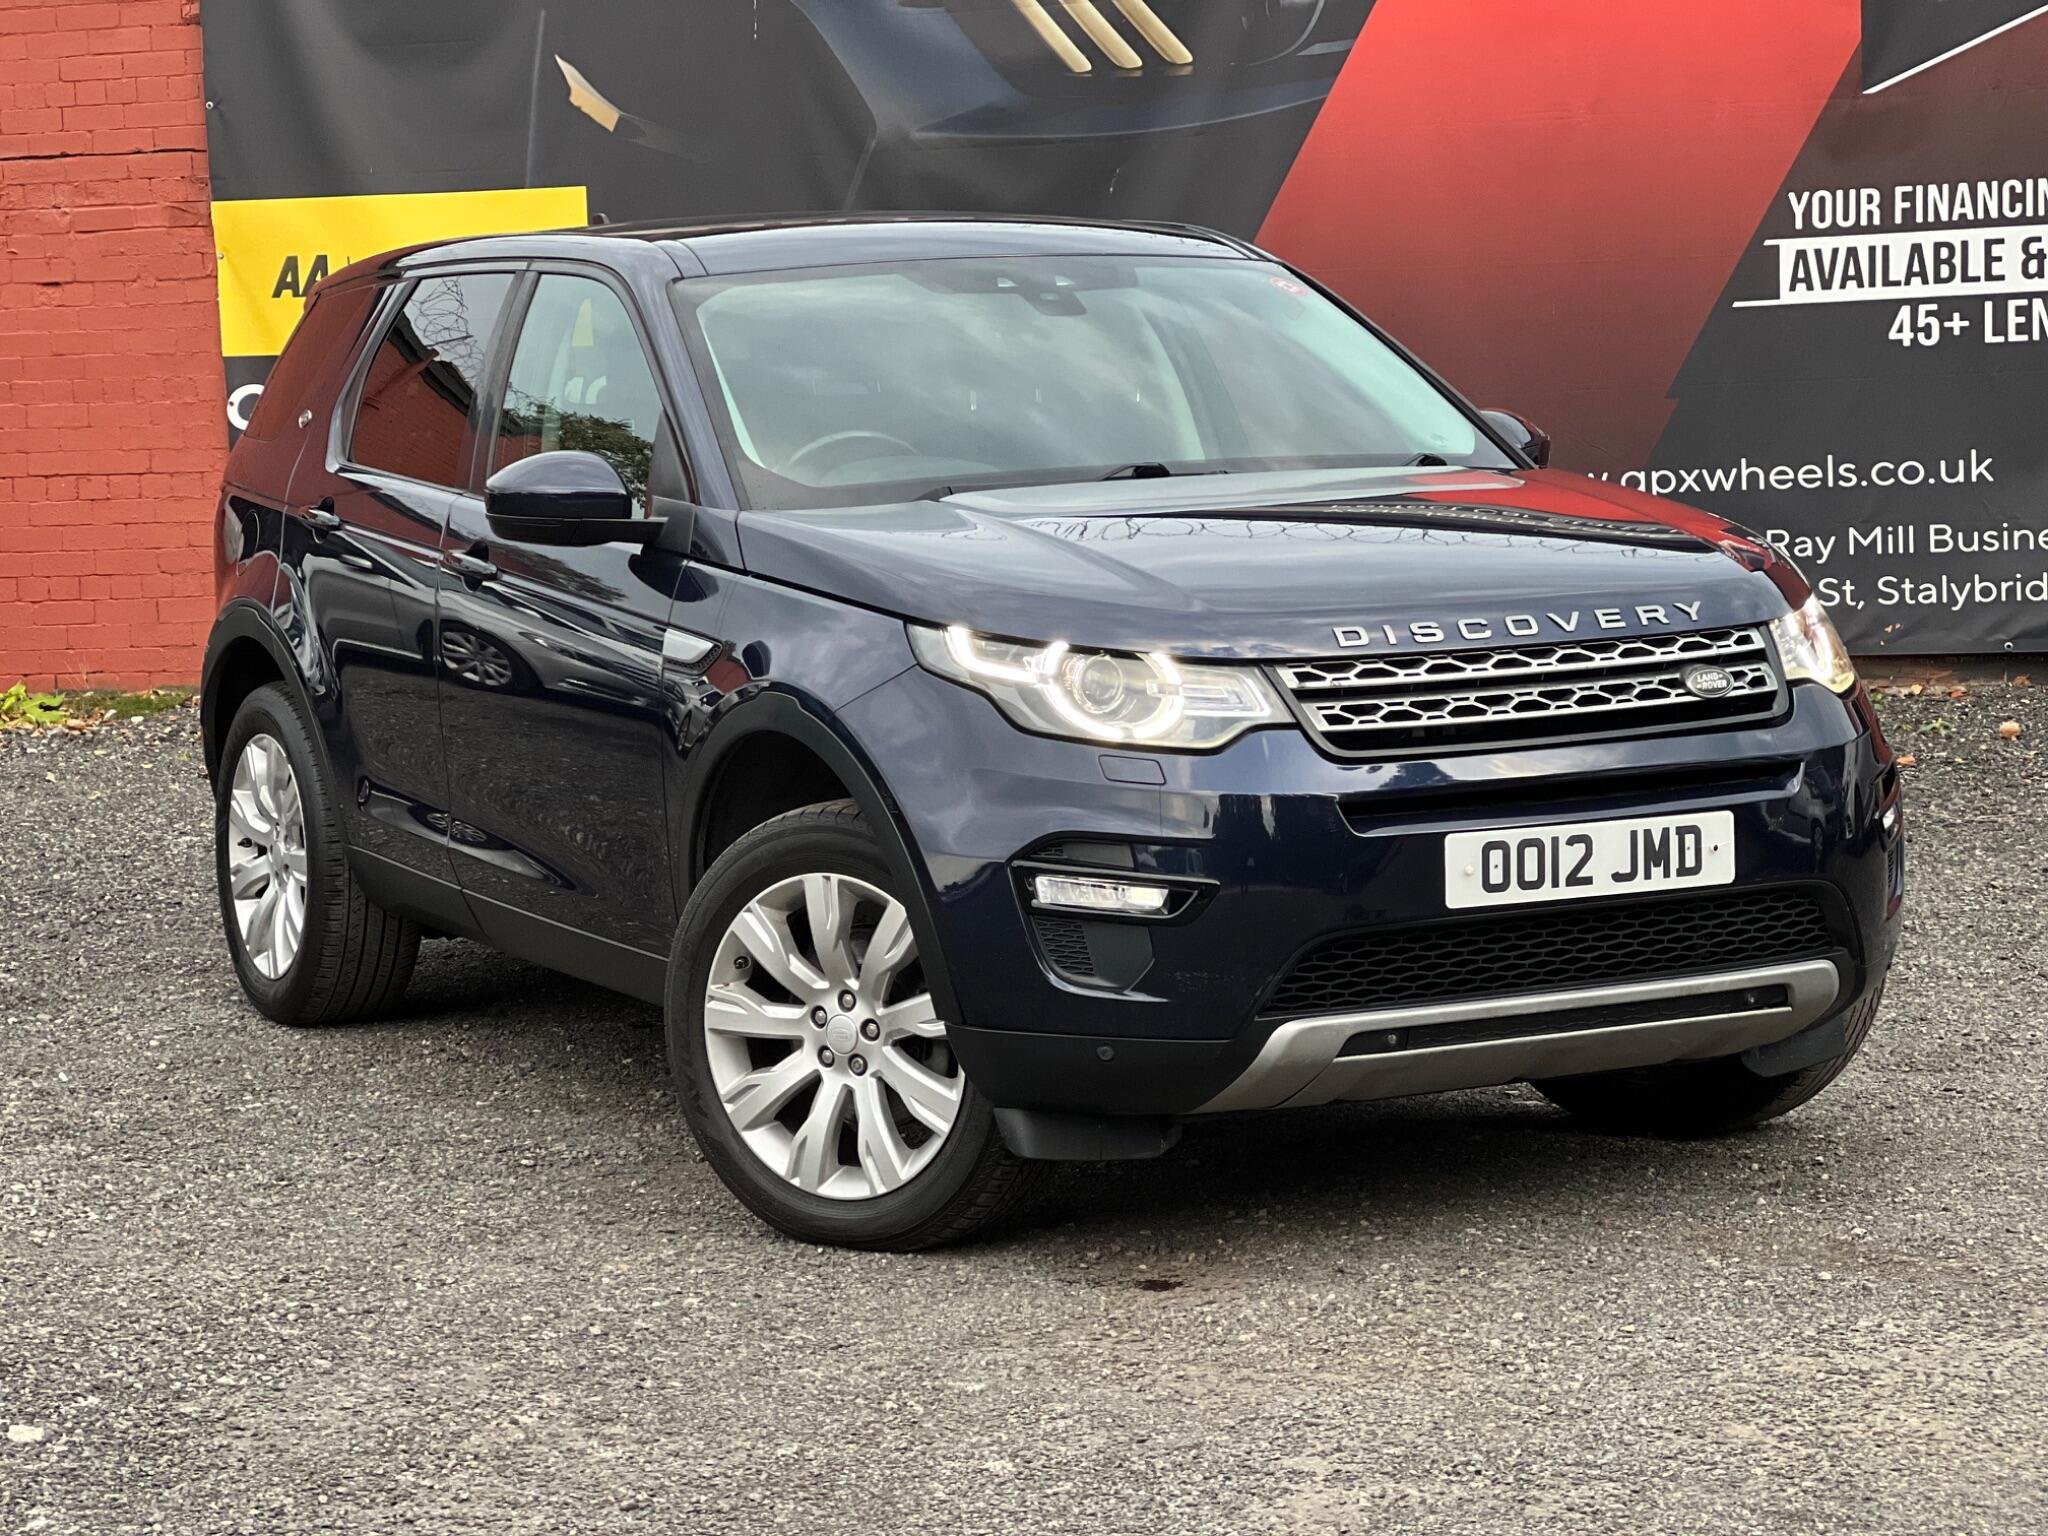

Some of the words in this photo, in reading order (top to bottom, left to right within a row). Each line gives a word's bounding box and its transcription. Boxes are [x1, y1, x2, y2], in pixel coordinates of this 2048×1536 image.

[1788, 188, 1881, 229] YOUR
[1788, 237, 2005, 292] AVAILABLE
[2021, 236, 2047, 280] &
[1888, 303, 1970, 346] 45+
[1984, 297, 2048, 343] LEN
[1766, 529, 1836, 564] Ray
[1848, 525, 1915, 556] Mill
[1818, 577, 1865, 617] St,
[1877, 571, 2048, 611] Stalybrid
[1332, 601, 1702, 647] DISCOVERY
[1611, 824, 1702, 883] JMD
